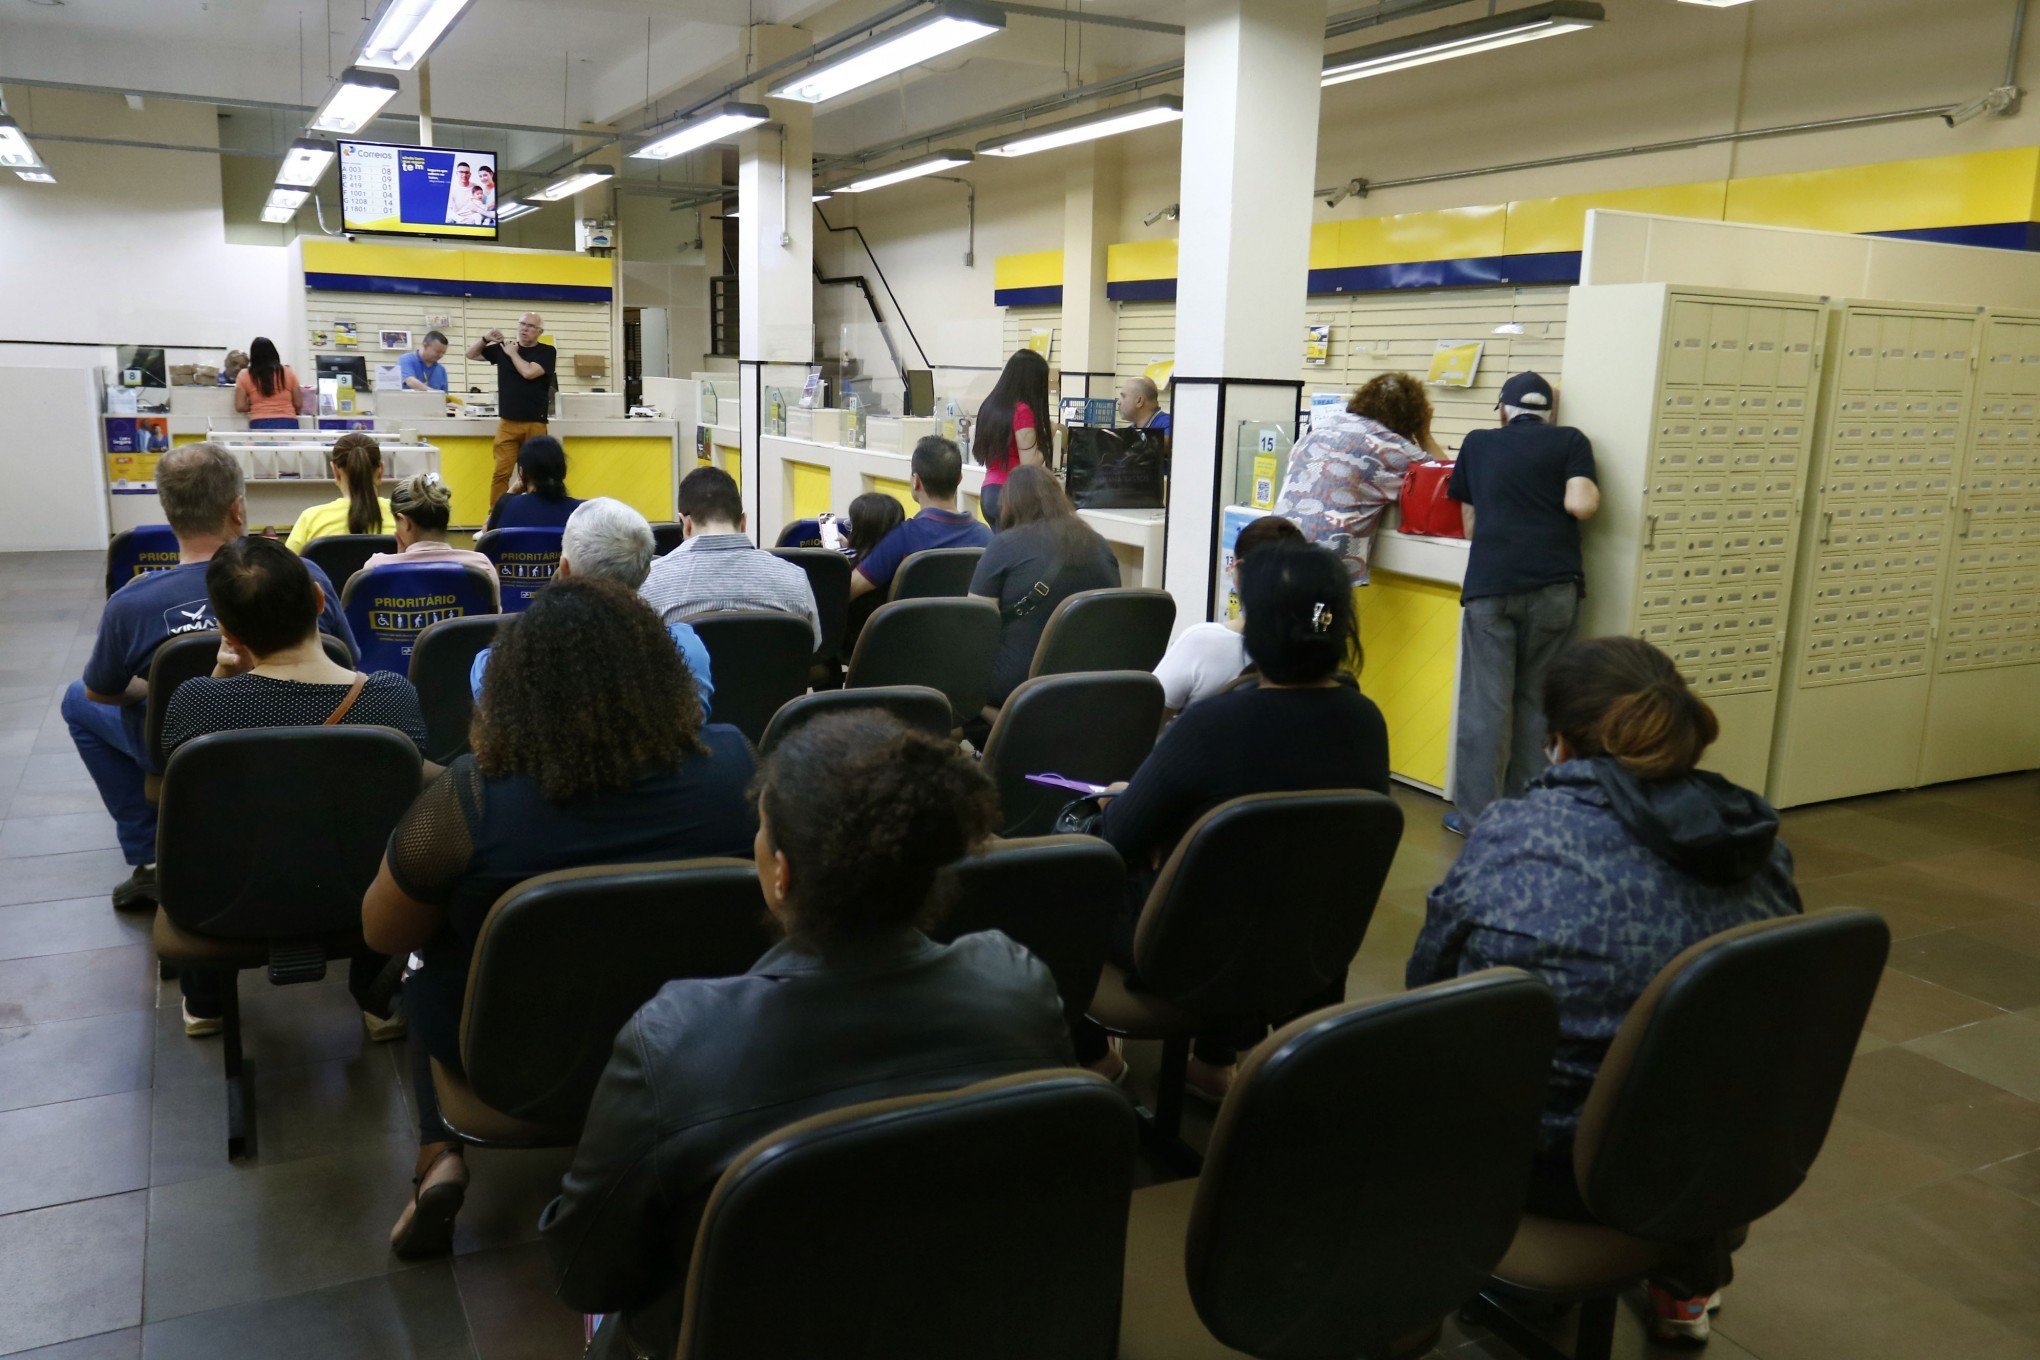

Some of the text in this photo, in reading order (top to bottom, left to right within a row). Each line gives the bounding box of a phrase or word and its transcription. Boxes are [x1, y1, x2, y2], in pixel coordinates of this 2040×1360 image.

[357, 150, 392, 159] Correios
[129, 372, 136, 380] 8
[341, 376, 347, 384] 9
[947, 405, 954, 416] 14
[1261, 437, 1274, 452] 15
[800, 538, 821, 547] PRIO
[374, 593, 456, 608] PRIORITÁRIO
[170, 617, 217, 634] VIMA
